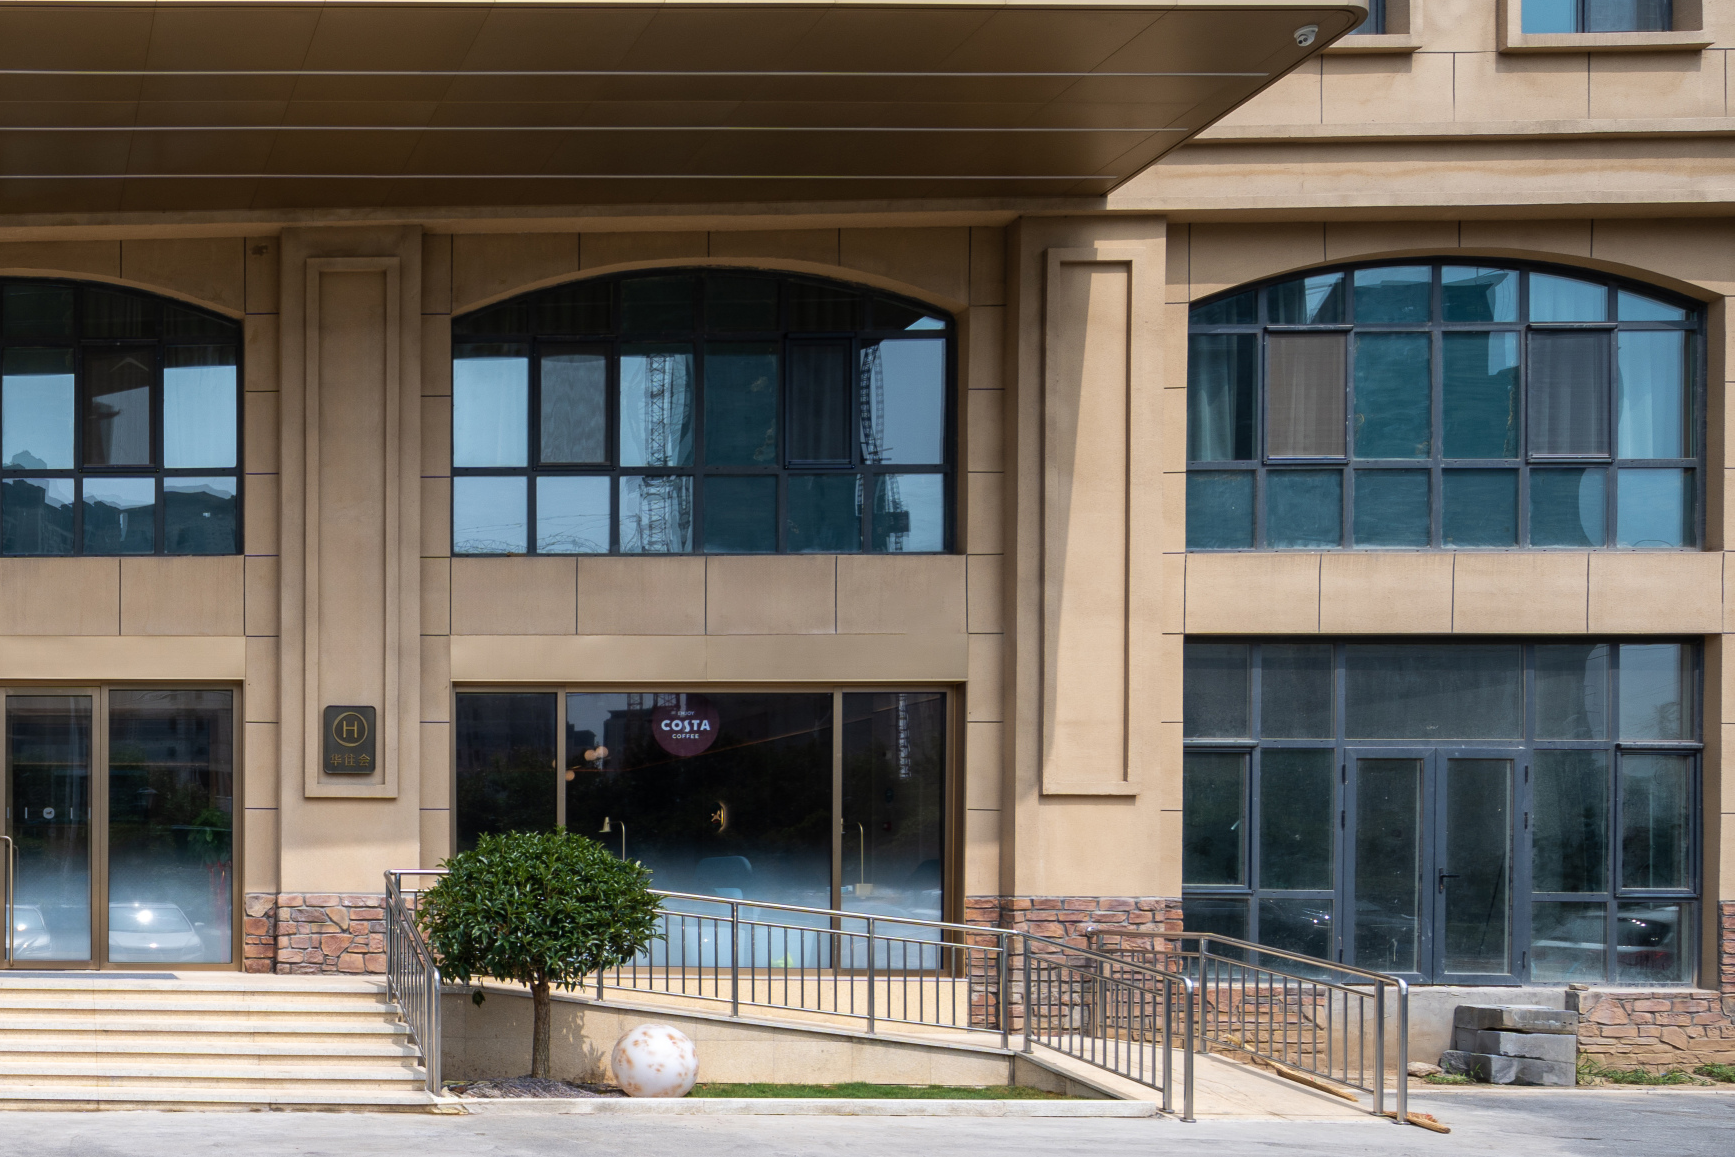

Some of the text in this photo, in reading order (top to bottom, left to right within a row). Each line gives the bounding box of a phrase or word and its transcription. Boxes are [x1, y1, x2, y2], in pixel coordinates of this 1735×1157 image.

[661, 719, 711, 733] COSTA
[330, 753, 371, 767] 华住会
